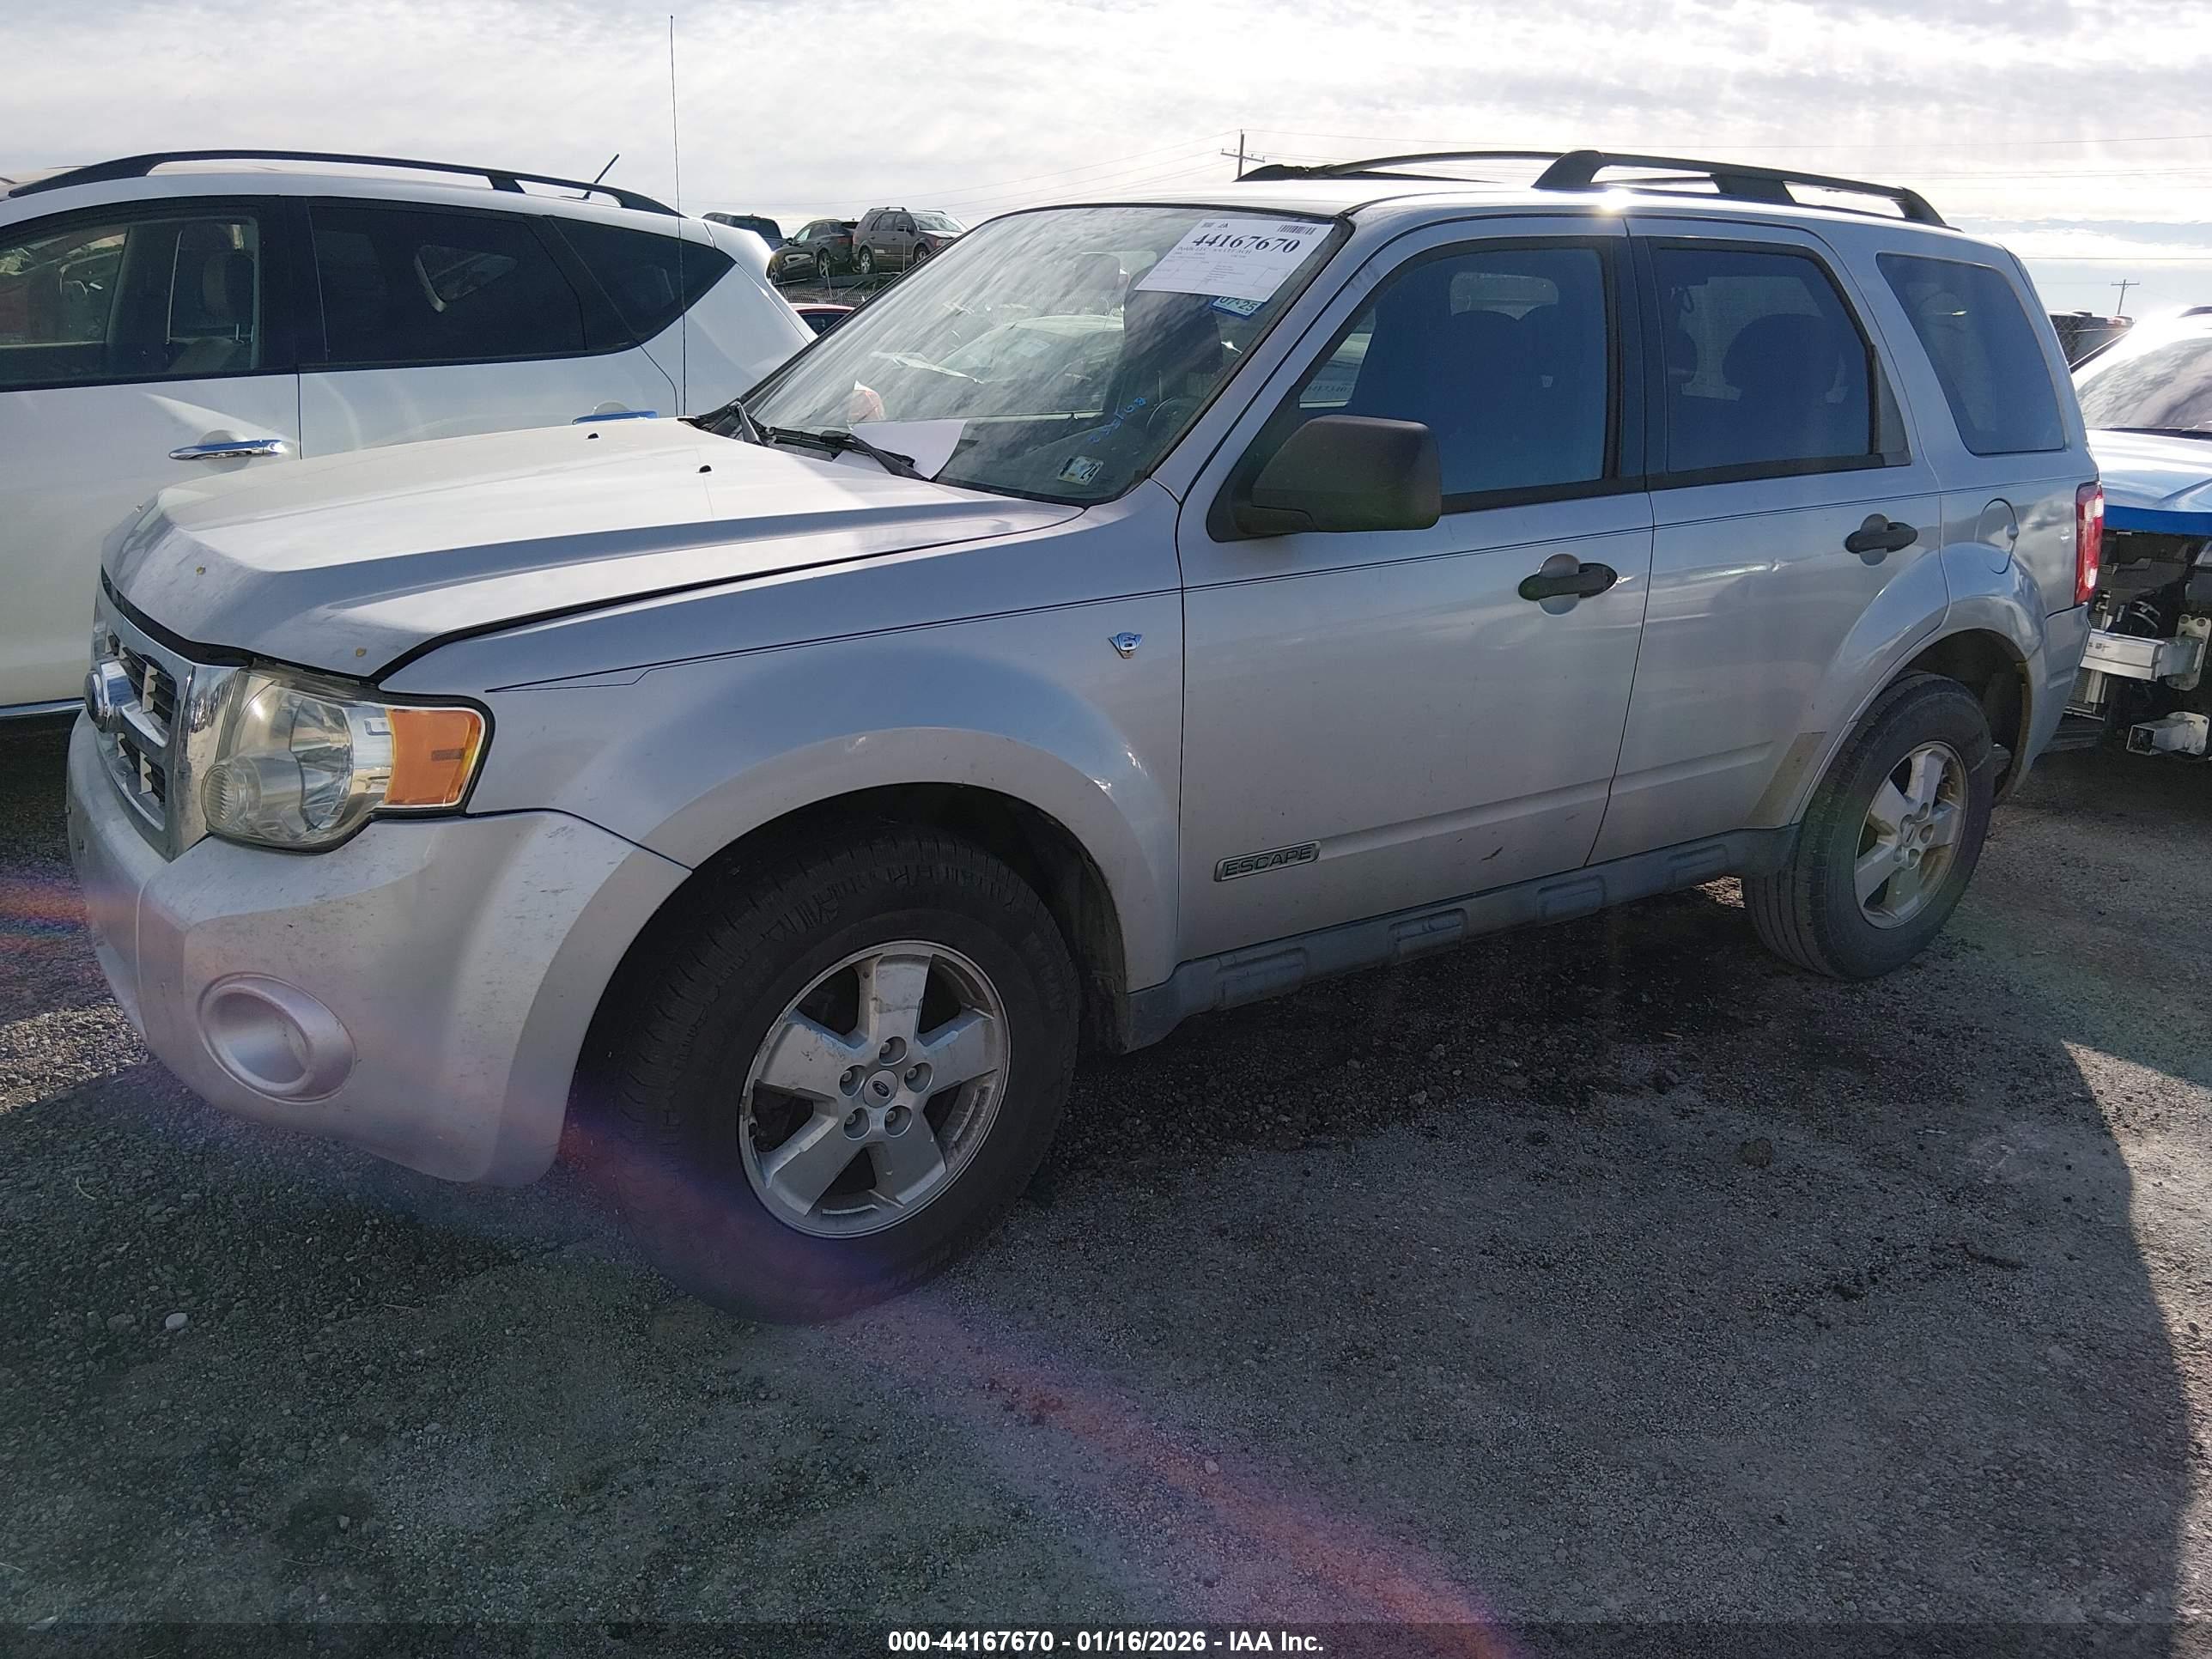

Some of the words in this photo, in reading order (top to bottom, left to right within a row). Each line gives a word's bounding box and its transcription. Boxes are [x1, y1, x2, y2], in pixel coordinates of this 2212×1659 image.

[1193, 233, 1301, 253] 44167670
[1238, 301, 1257, 312] 25
[1224, 843, 1314, 876] ESCAPE
